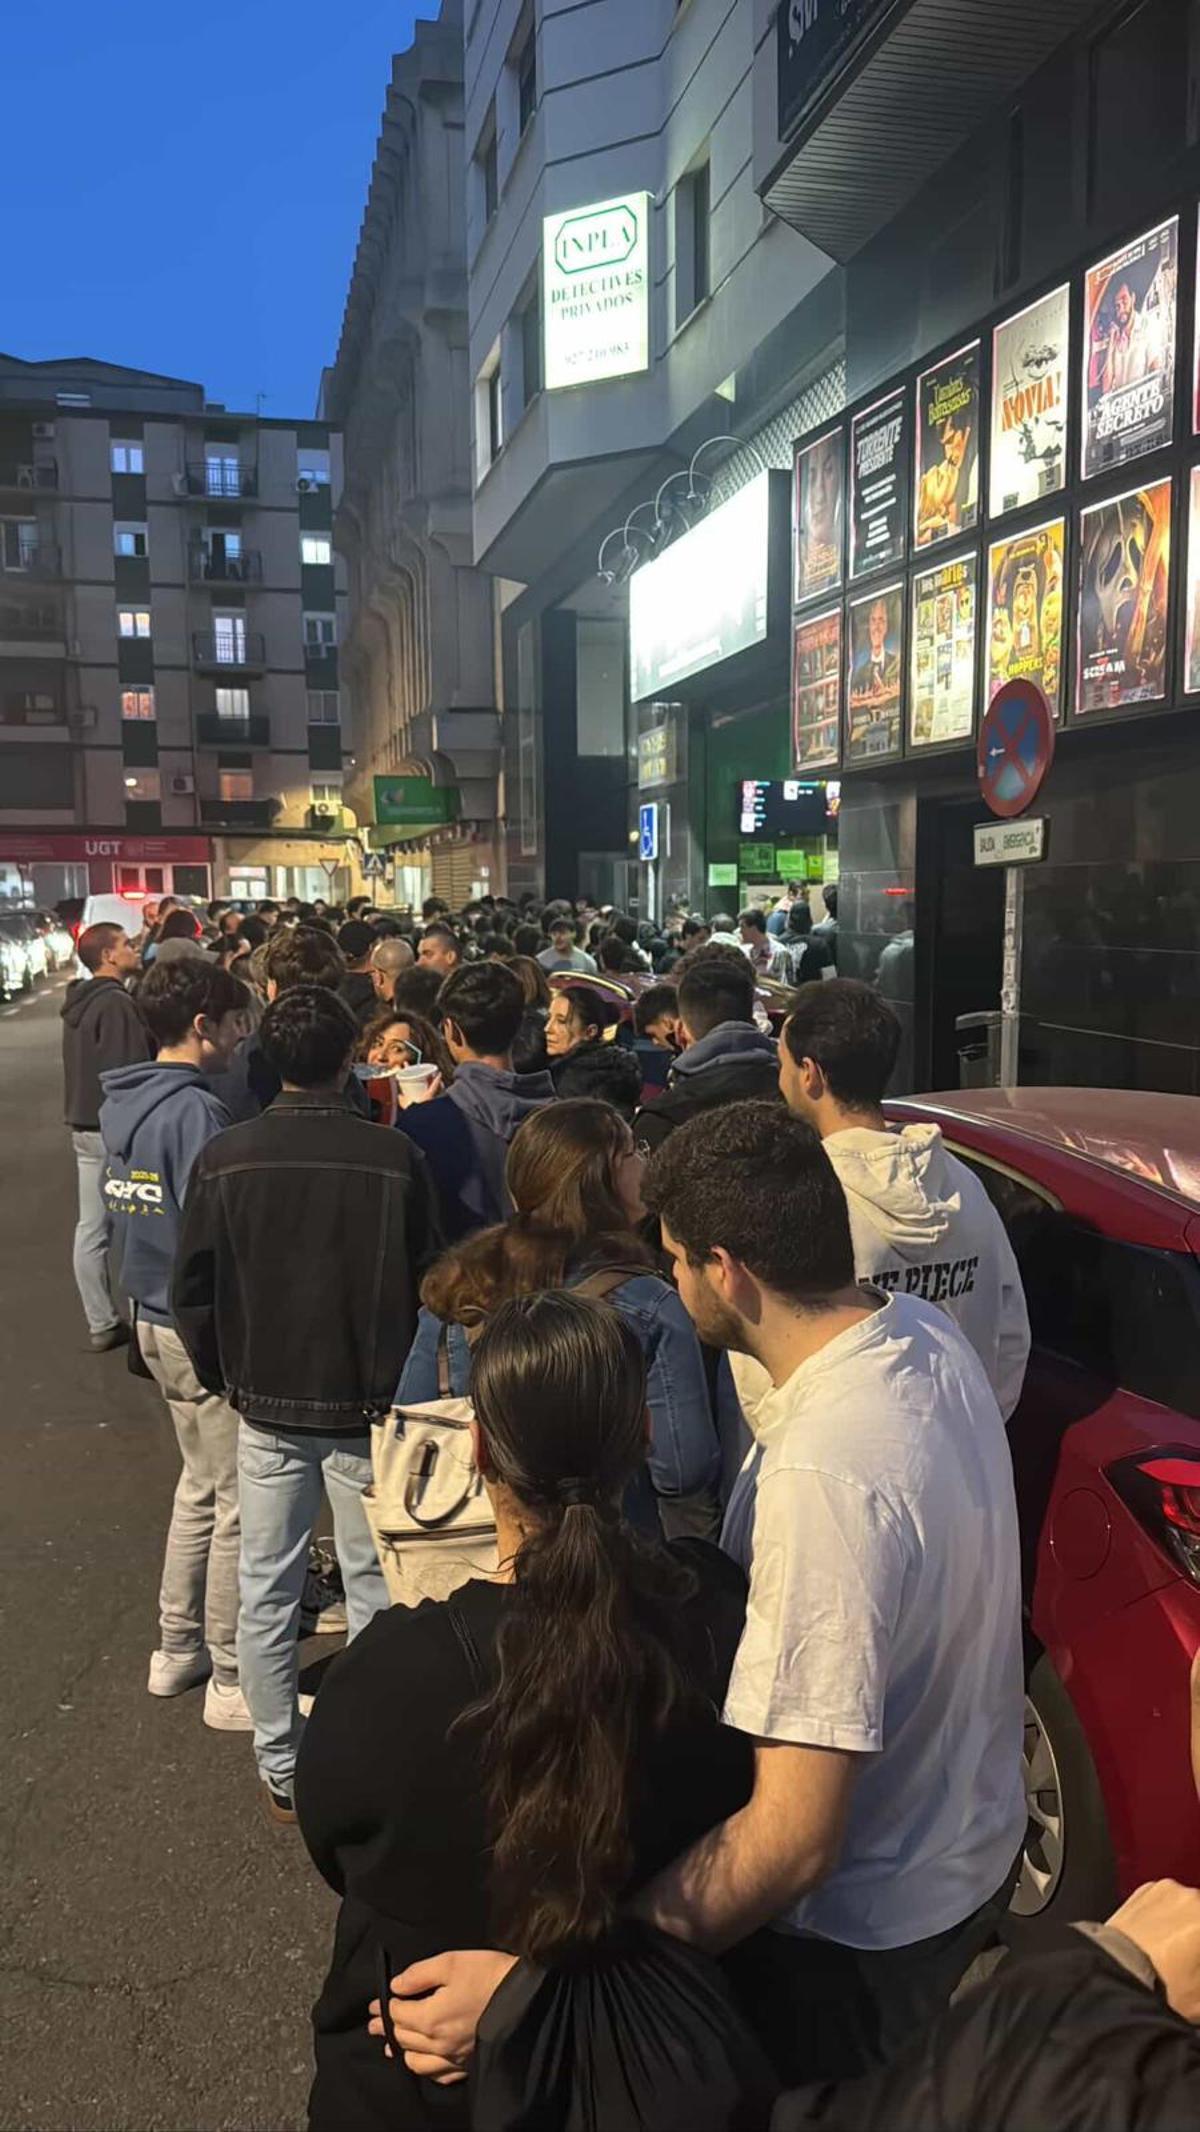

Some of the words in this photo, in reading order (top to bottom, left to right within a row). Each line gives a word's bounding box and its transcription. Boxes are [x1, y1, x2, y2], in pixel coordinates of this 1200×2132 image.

[562, 226, 631, 259] INPLA
[551, 269, 644, 304] DETECTIVES
[561, 291, 634, 321] PRIVADOS
[1101, 378, 1161, 418] AGENTE
[1096, 394, 1164, 440] SECRETO
[857, 415, 903, 465] TORRENTE
[85, 840, 122, 856] UGT
[905, 1256, 979, 1303] PIECE
